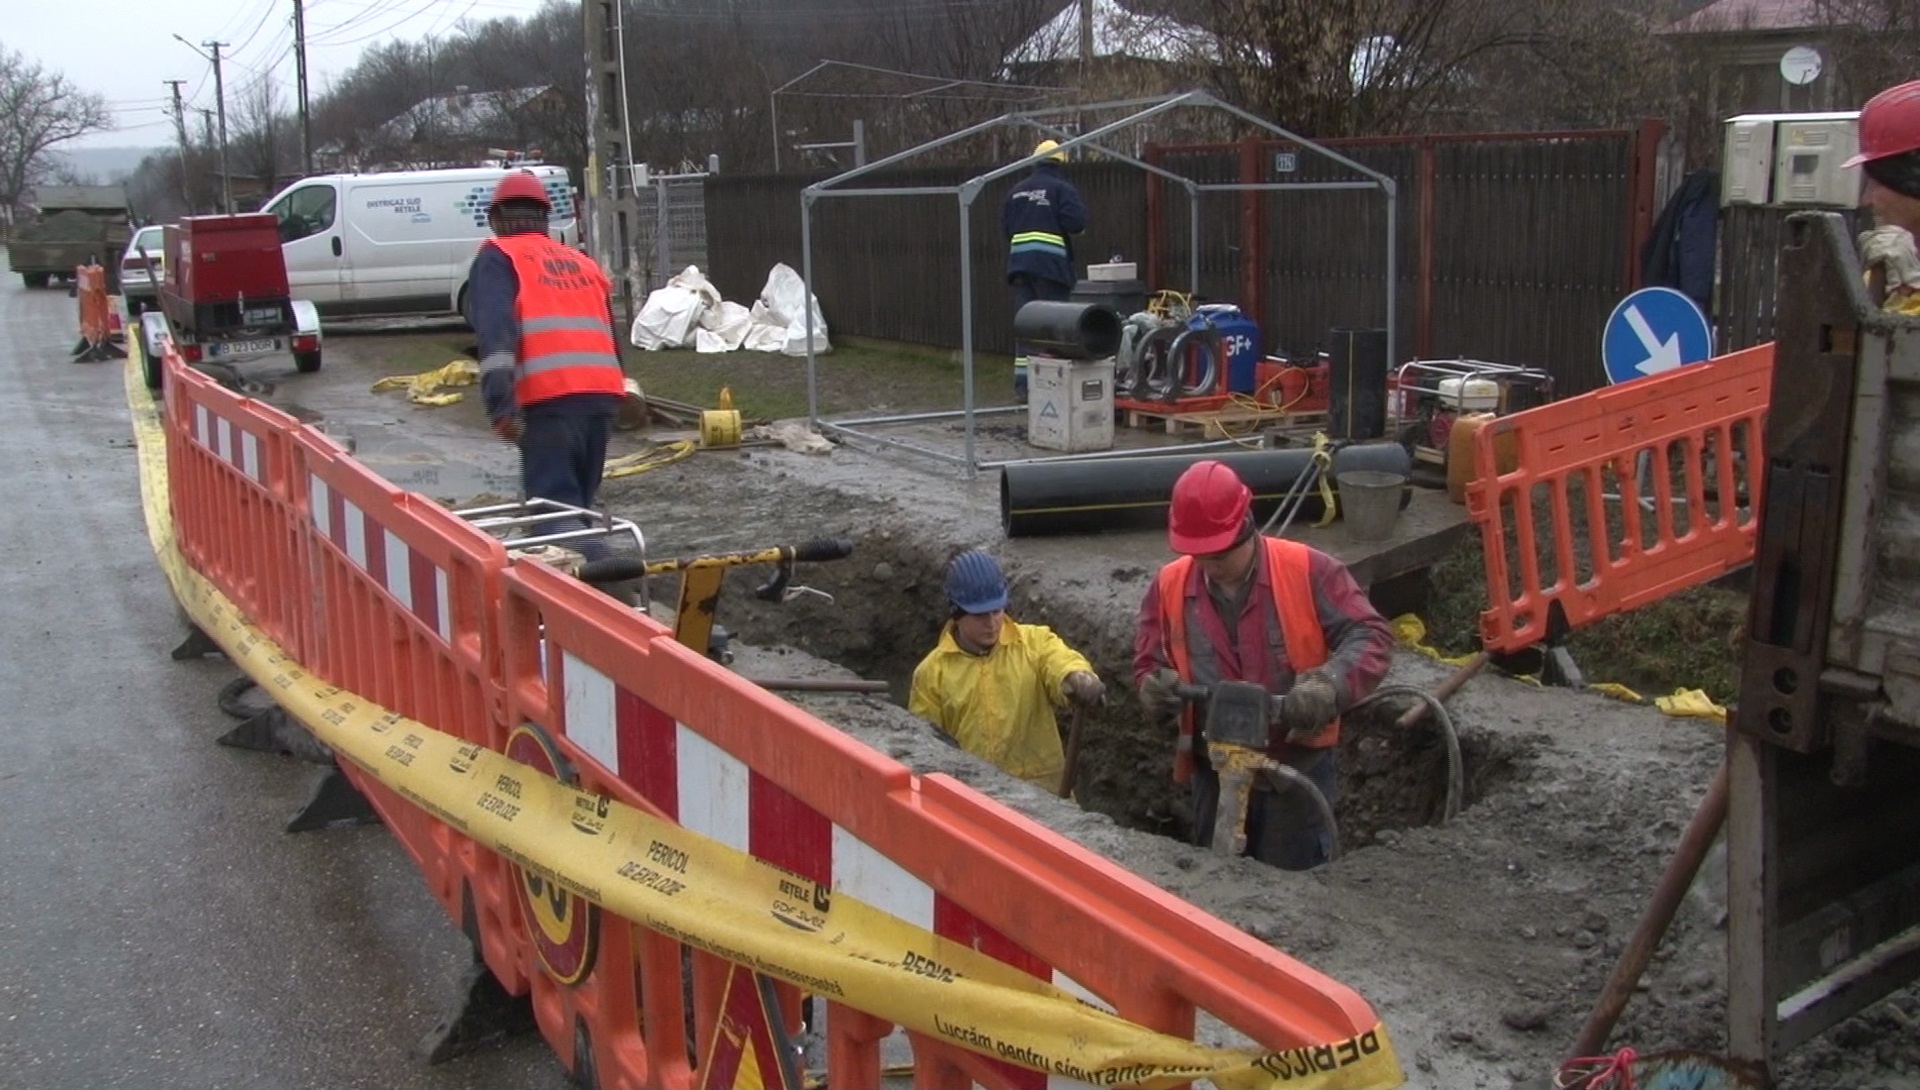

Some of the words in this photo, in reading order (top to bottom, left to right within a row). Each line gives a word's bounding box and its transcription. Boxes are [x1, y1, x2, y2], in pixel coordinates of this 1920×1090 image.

[617, 861, 641, 878] DE
[630, 867, 687, 897] EXPLOZIE
[646, 840, 690, 875] PERICOL
[934, 1014, 993, 1051] Lucrăm
[995, 1040, 1051, 1073] pentru
[1252, 1029, 1380, 1080] PERICOL
